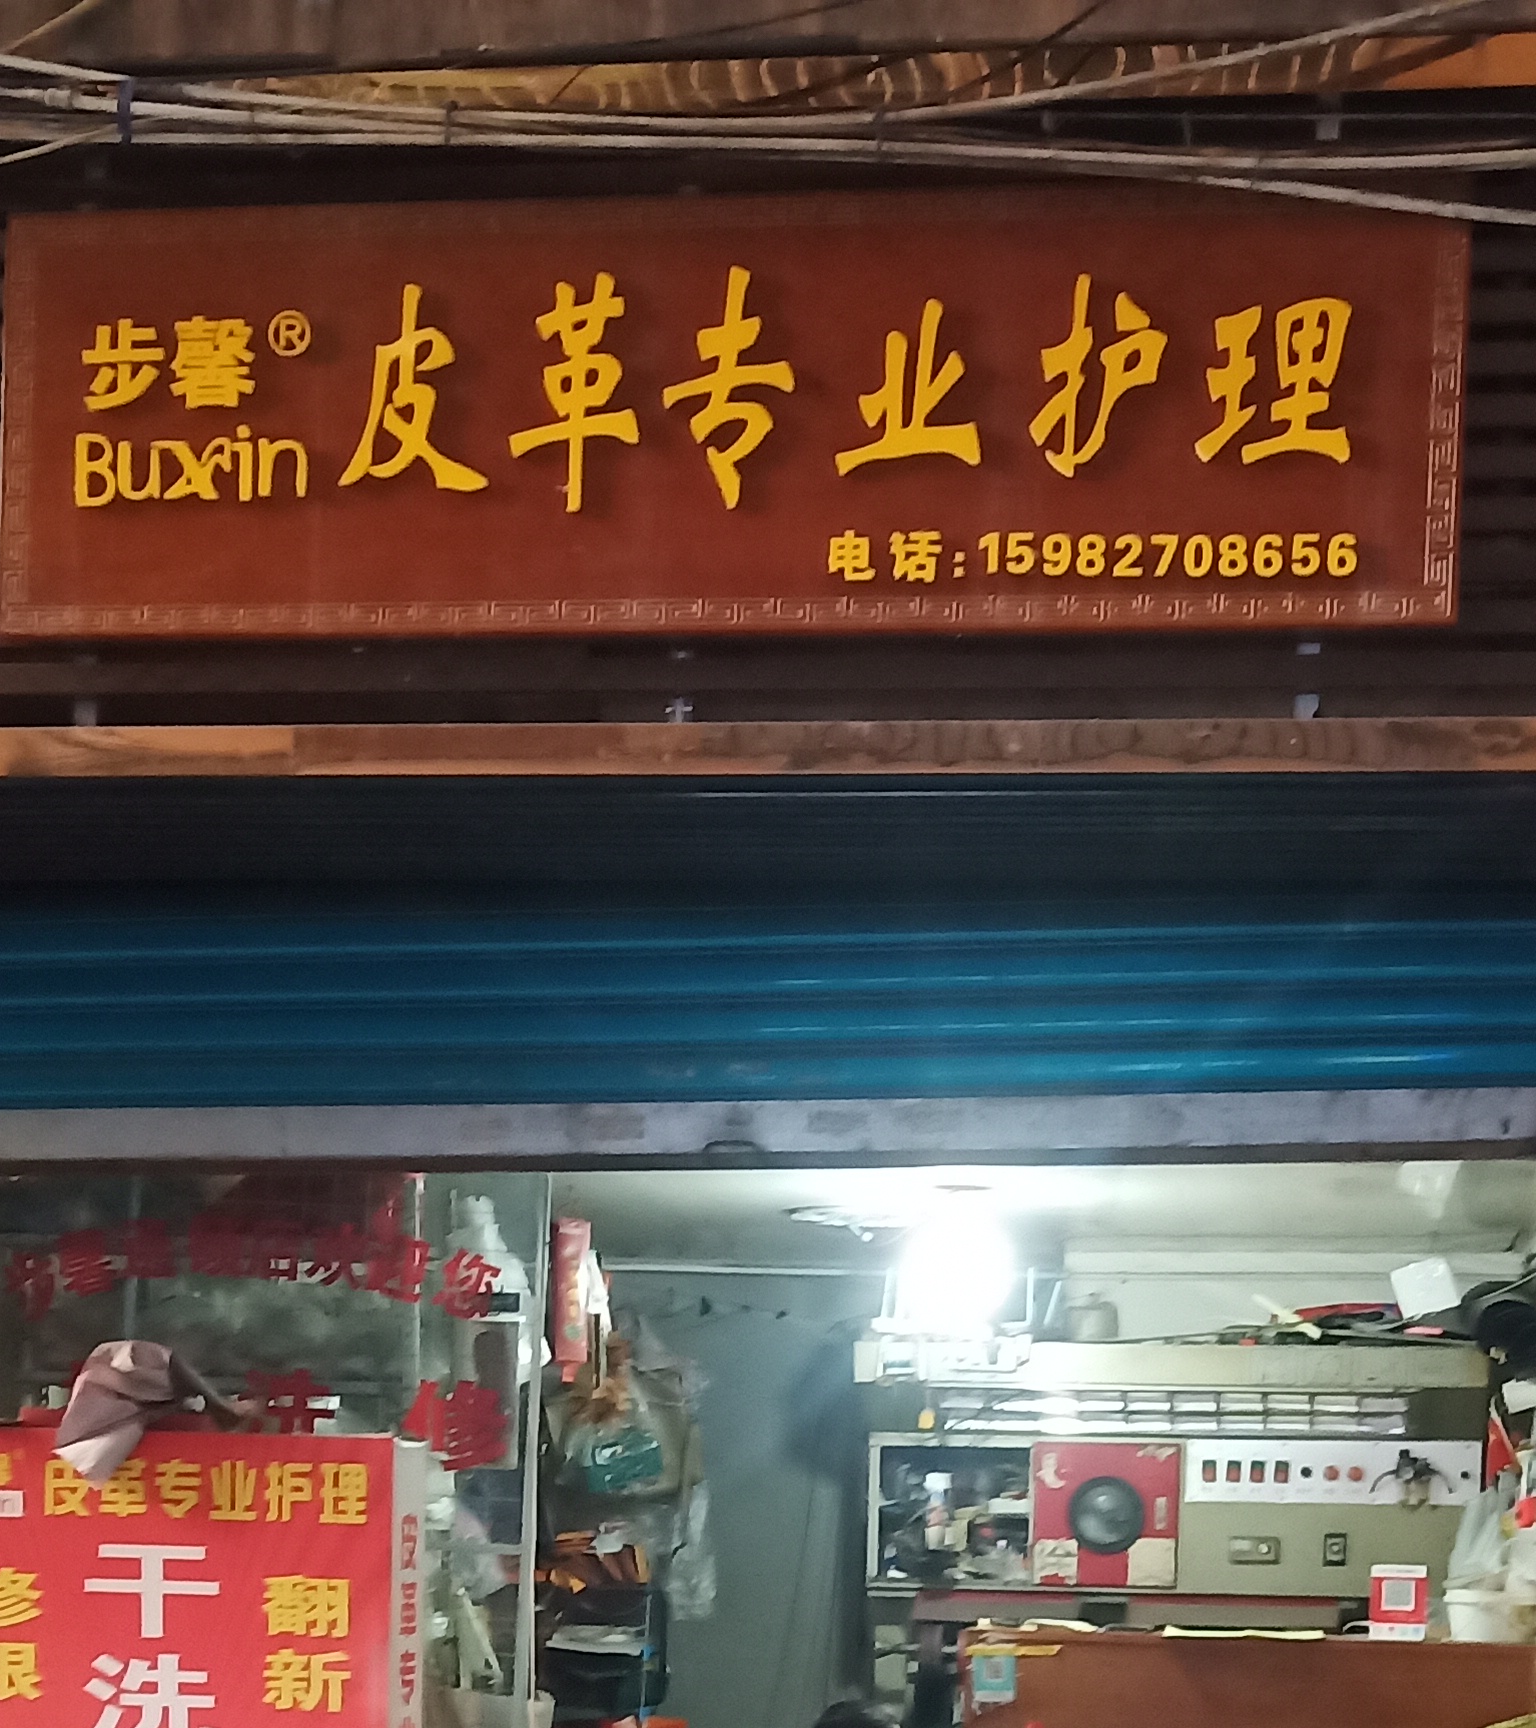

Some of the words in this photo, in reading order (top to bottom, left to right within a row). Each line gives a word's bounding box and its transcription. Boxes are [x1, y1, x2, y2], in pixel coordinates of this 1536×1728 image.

[338, 265, 1354, 513] 皮革专业护理
[74, 425, 309, 508] Buxin
[43, 1457, 369, 1525] 皮革专业护理
